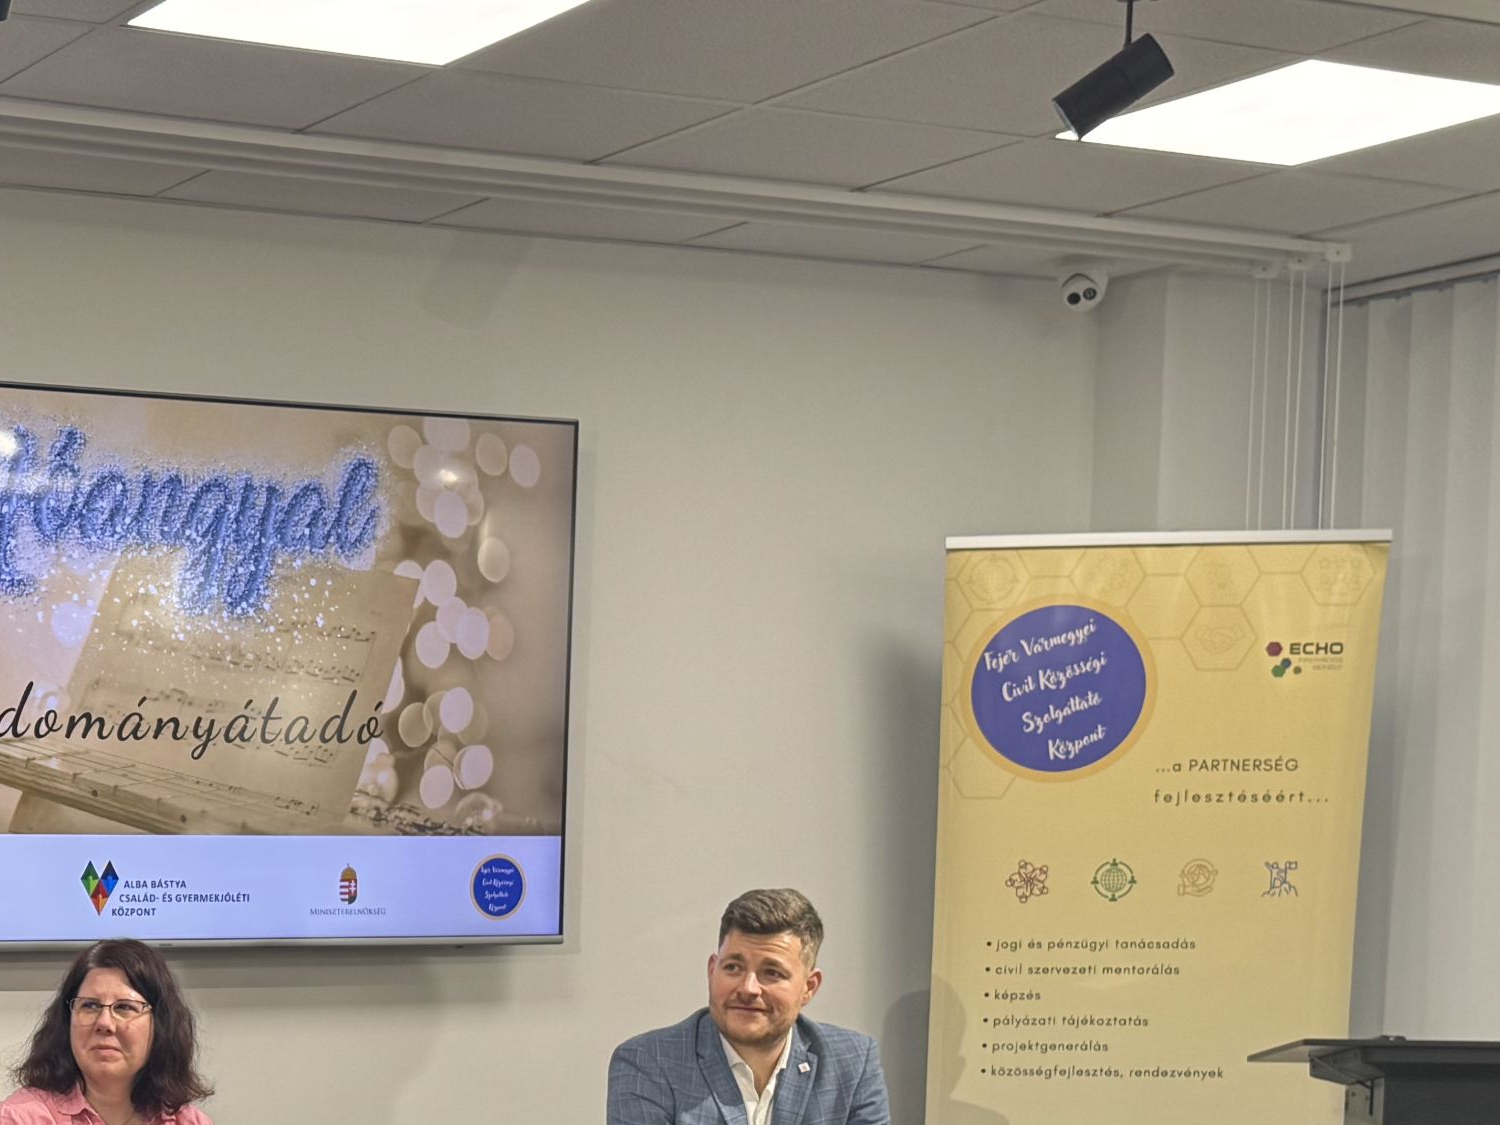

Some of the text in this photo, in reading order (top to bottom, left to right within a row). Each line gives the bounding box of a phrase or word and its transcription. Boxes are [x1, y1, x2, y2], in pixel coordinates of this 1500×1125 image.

[1020, 618, 1097, 657] Vármegyei
[1289, 642, 1344, 656] ECHO
[1002, 651, 1108, 703] Civil Közösségi
[1048, 724, 1107, 761] Központ
[1188, 755, 1299, 773] PARTNERSÉG
[123, 878, 187, 889] ALBA BÁSTYA
[162, 892, 173, 903] ÉS
[175, 892, 250, 903] GYERMEKJÓLÉTI
[111, 906, 156, 917] KÖZPONT
[995, 938, 1196, 953] jogi és pénzügyi tanácsadás
[995, 964, 1180, 976] civil szervezeti mentorálás
[994, 989, 1041, 1001] képzés
[992, 1015, 1149, 1029] pályázati tájékoztatás
[992, 1040, 1109, 1055] projektgenerálás
[990, 1065, 1224, 1081] közösségfejlesztés, rendezvények
